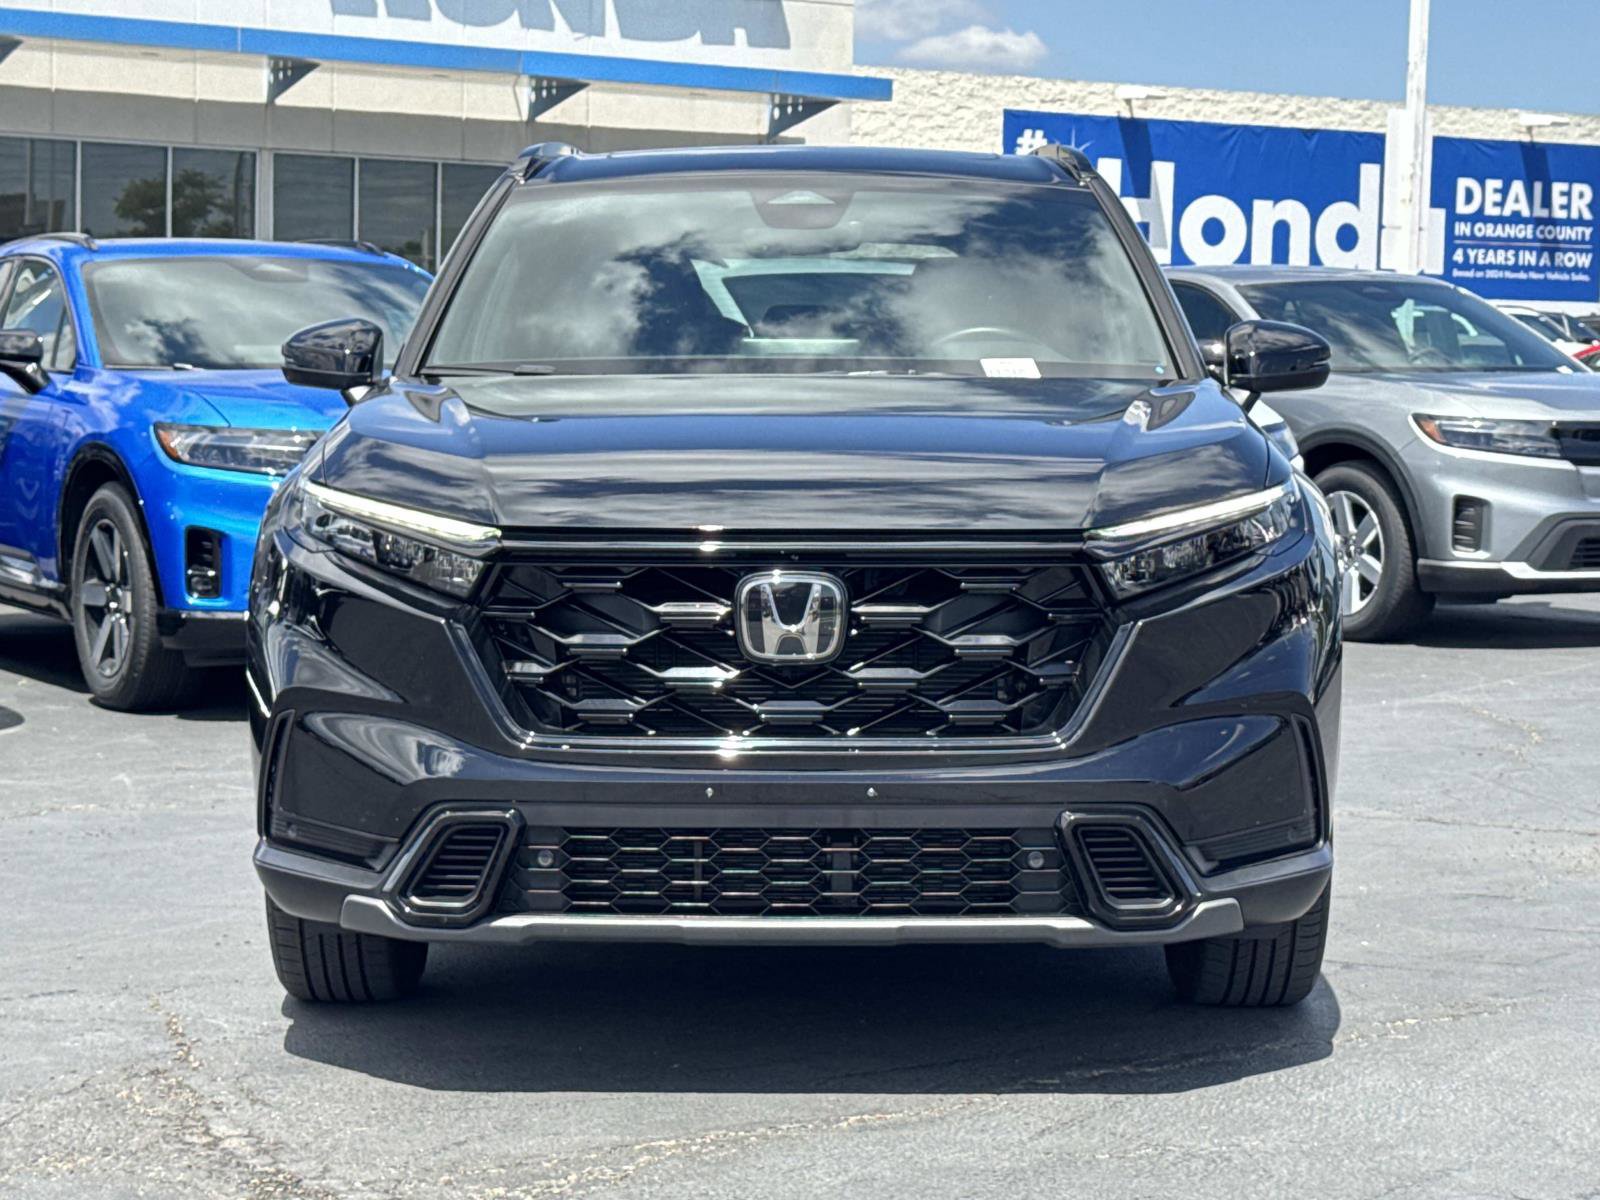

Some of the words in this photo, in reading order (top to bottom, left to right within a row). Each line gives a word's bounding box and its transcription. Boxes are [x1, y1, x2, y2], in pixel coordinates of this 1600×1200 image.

[1455, 177, 1593, 220] DEALER
[1454, 221, 1471, 237] IN
[1473, 222, 1534, 239] ORANGE
[1536, 225, 1593, 241] COUNTY
[1452, 248, 1464, 264] 4
[1467, 248, 1515, 266] YEARS
[1518, 250, 1537, 267] IN
[1539, 251, 1551, 267] A
[1553, 252, 1593, 269] ROW
